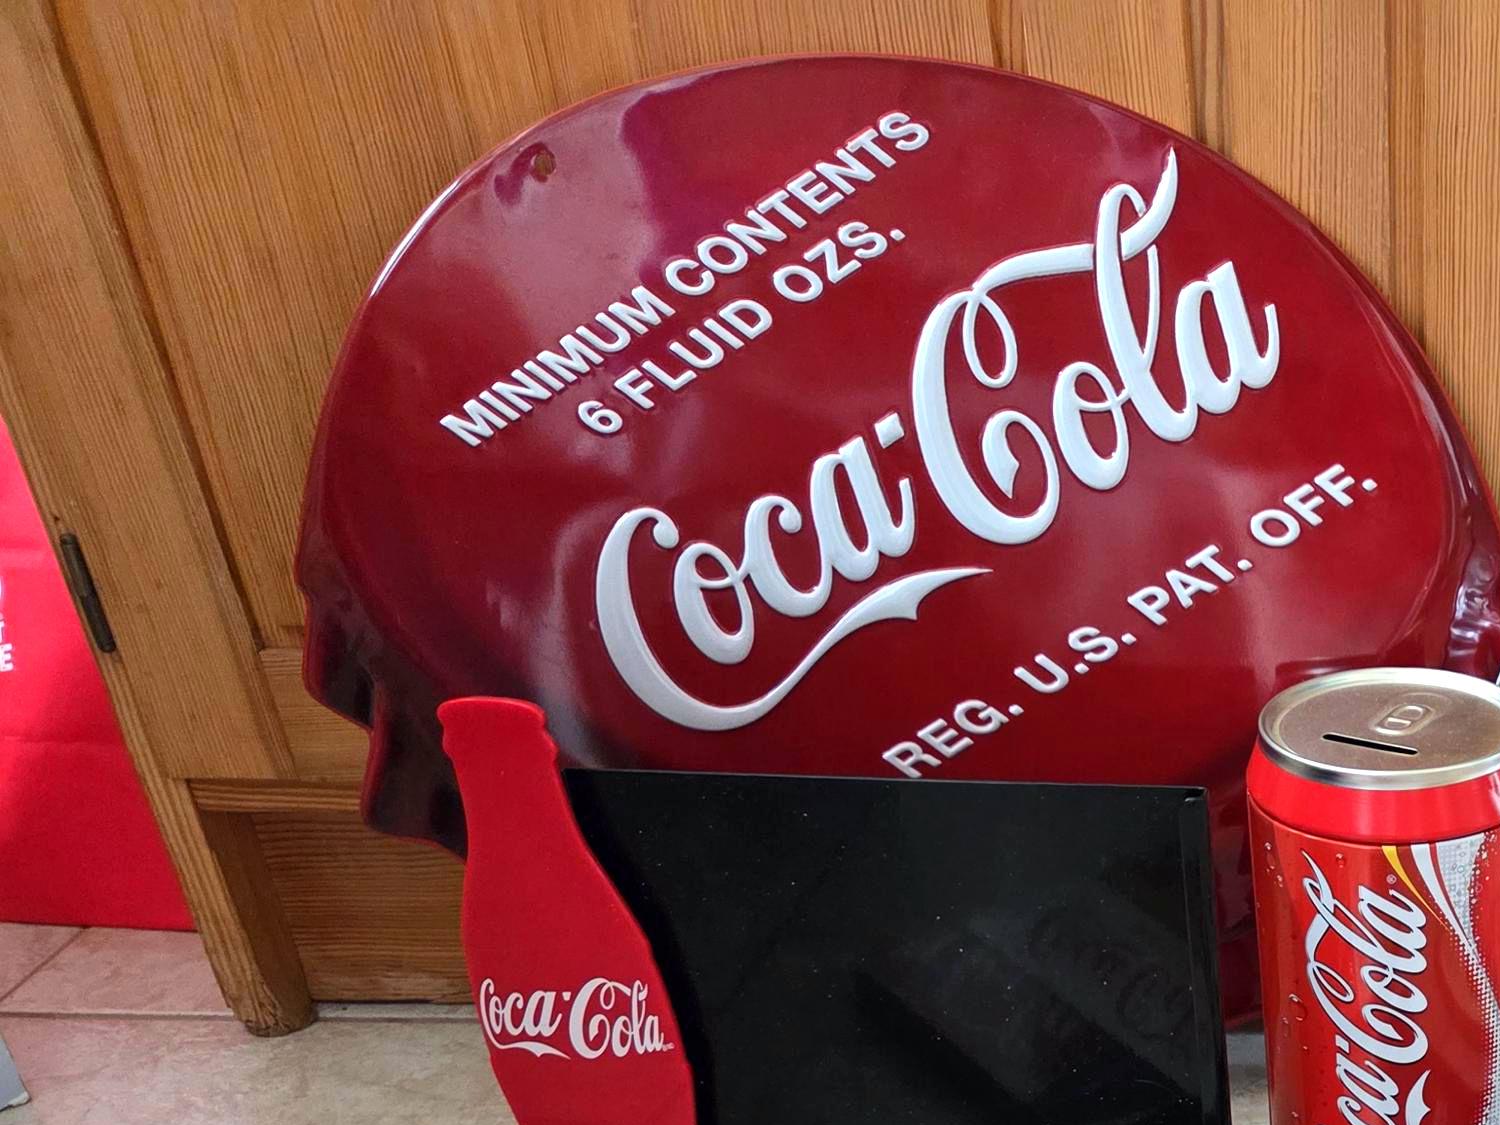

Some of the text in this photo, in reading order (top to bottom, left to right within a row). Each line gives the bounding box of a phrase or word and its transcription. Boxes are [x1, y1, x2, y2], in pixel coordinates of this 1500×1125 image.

[440, 111, 931, 447] MINIMUM CONTENTS
[578, 221, 905, 436] 6 FLUID OZS.
[596, 145, 1280, 733] Coca-Cola
[883, 462, 1378, 777] REG. U.S. PAT. OFF.
[480, 977, 664, 1060] Coca-Cola
